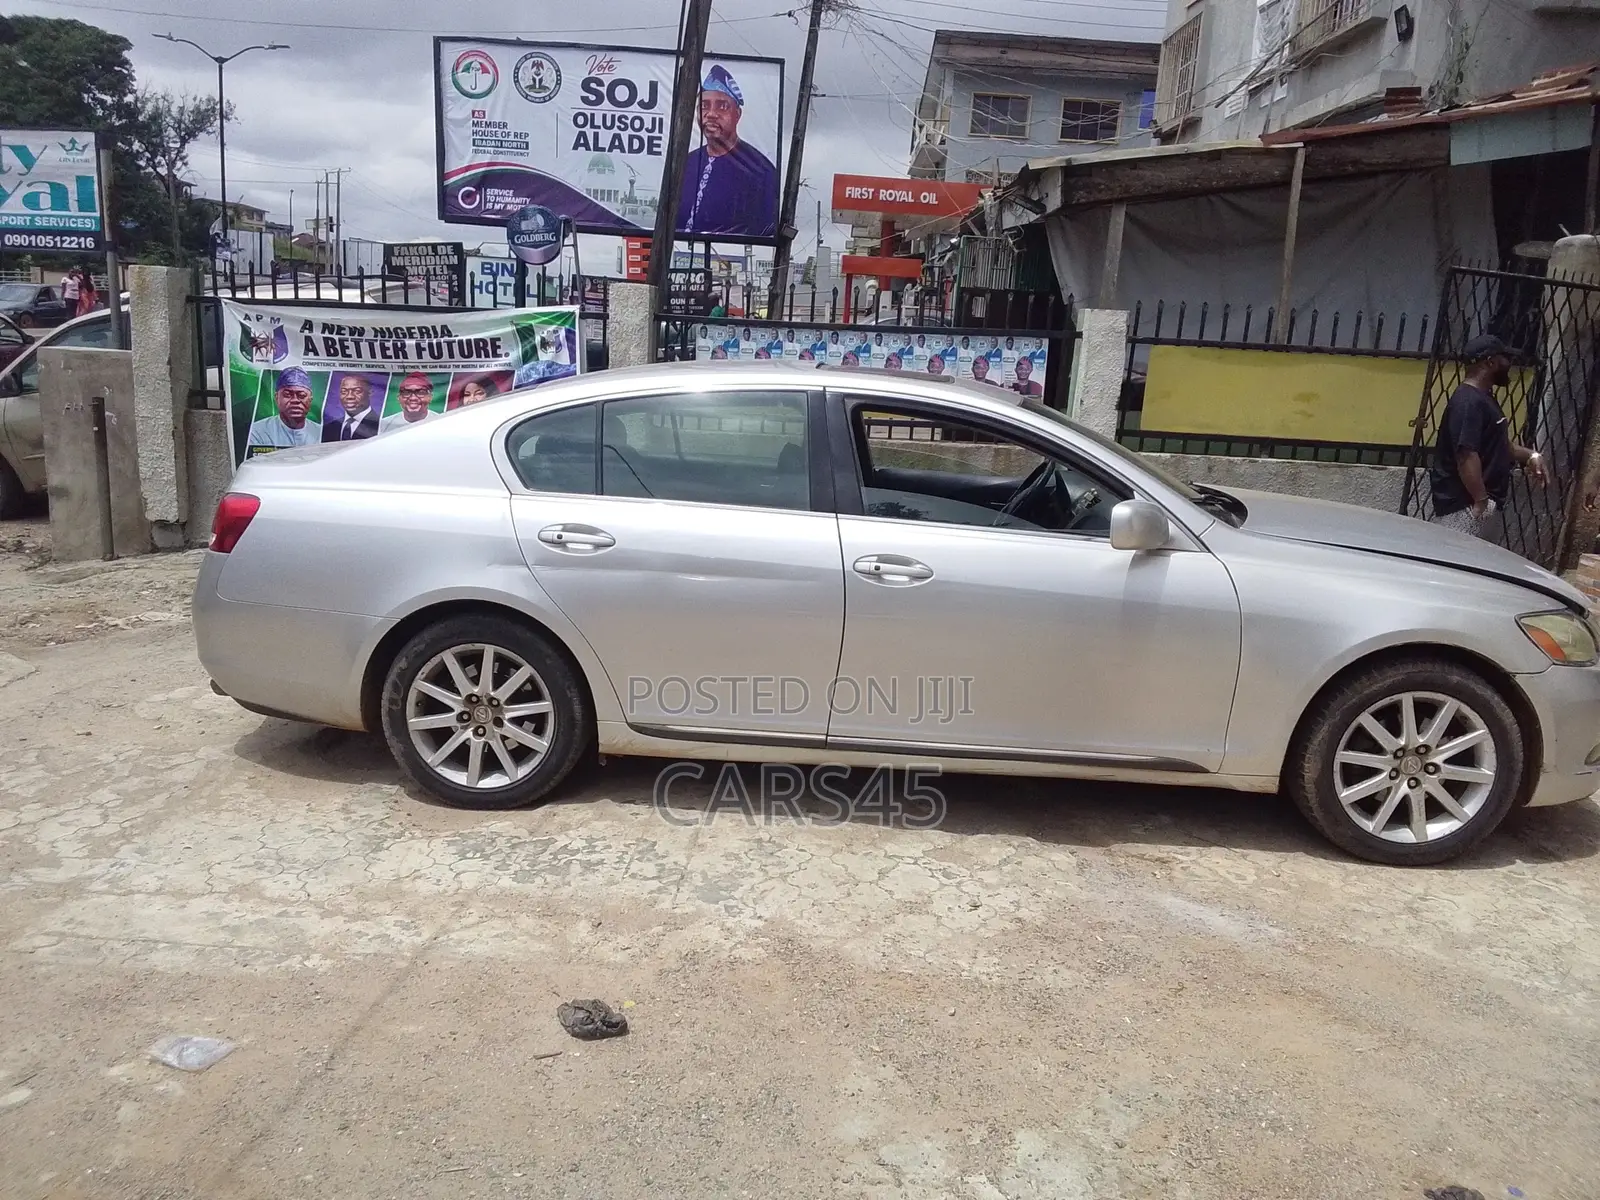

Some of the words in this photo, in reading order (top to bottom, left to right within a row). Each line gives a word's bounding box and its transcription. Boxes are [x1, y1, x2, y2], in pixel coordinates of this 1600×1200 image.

[585, 53, 621, 75] Vote
[580, 76, 659, 110] SOJ
[472, 120, 508, 130] MEMBER
[572, 111, 664, 134] OLUSOJI
[472, 129, 500, 138] HOUSE
[501, 131, 512, 139] OF
[513, 131, 530, 140] REP
[475, 139, 500, 147] IBADAN
[502, 141, 526, 149] NORTH
[572, 130, 662, 156] ALADE
[486, 188, 514, 196] SERVICE
[845, 186, 875, 200] FIRST
[879, 189, 915, 203] ROYAL
[920, 192, 939, 205] OIL
[496, 196, 531, 205] HUMANITY
[34, 218, 96, 230] SERVICES)
[4, 234, 95, 249] 09010512216
[514, 231, 557, 244] GOLDBERG
[437, 245, 455, 255] DE
[391, 255, 459, 266] MERIDIAN
[300, 319, 314, 333] A
[320, 322, 366, 338] NEW
[371, 324, 460, 340] NIGERIA.
[303, 335, 320, 357] A
[322, 336, 409, 360] BETTER
[415, 337, 511, 360] FUTURE.
